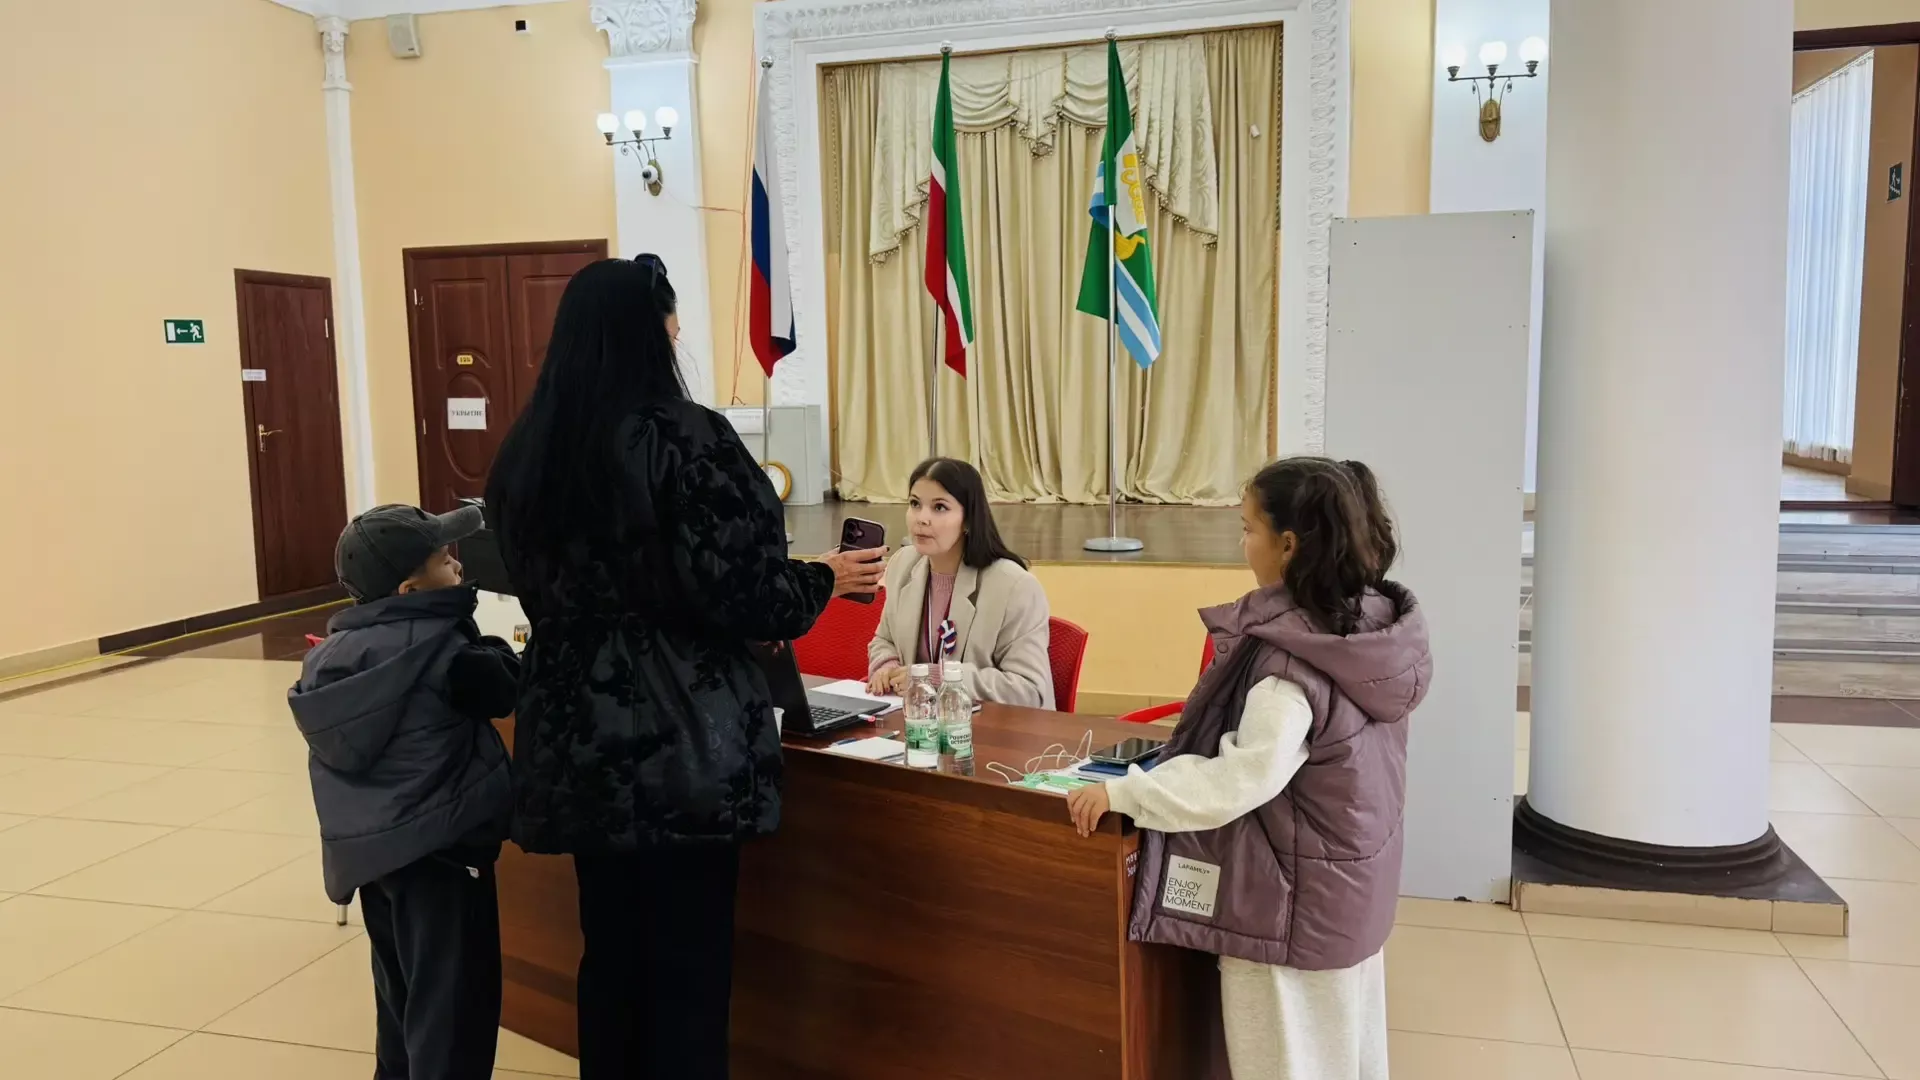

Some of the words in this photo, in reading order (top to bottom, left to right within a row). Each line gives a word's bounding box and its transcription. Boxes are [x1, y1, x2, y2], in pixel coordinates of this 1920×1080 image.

[1168, 877, 1201, 891] ENJOY
[1166, 886, 1198, 899] EVERY
[1165, 895, 1211, 912] MOMENT
